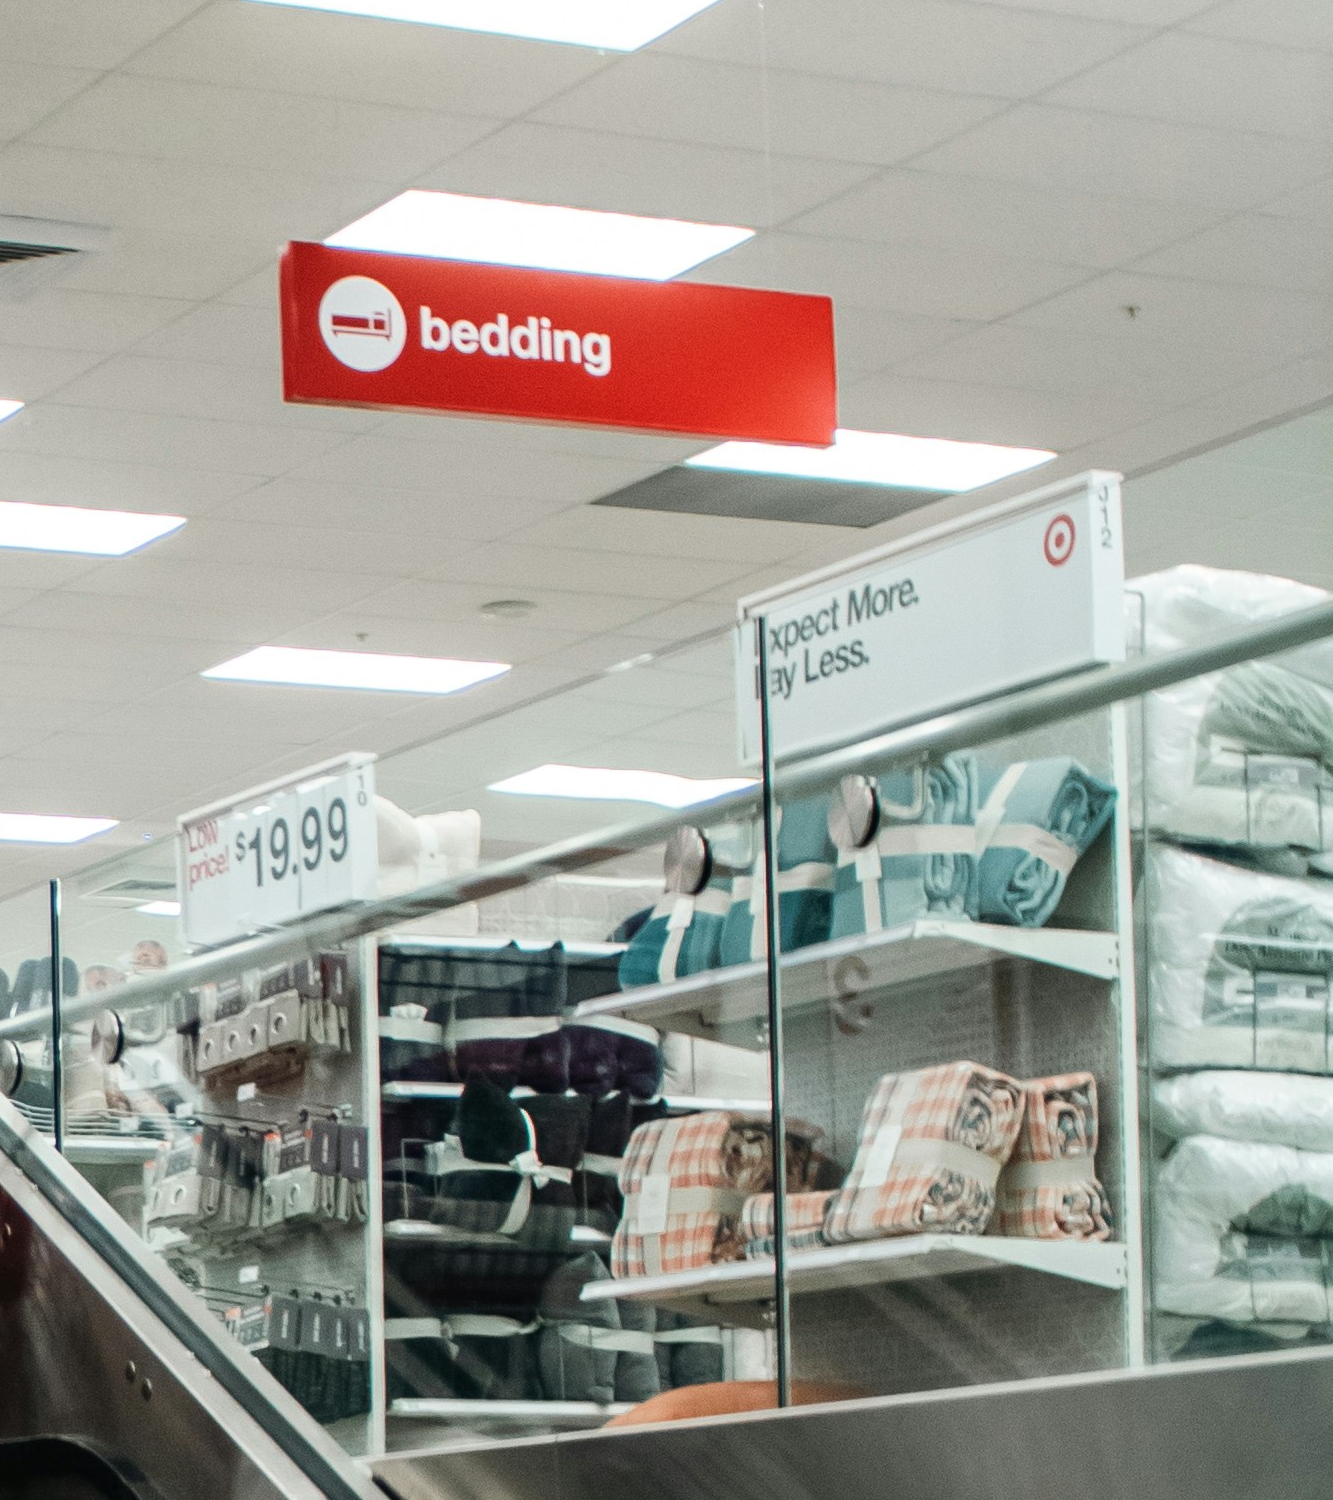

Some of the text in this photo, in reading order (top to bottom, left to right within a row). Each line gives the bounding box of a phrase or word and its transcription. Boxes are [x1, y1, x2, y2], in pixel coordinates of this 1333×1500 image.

[420, 305, 612, 377] bedding
[847, 577, 919, 627] More.
[804, 639, 870, 683] Less.
[235, 797, 349, 888] $19.99
